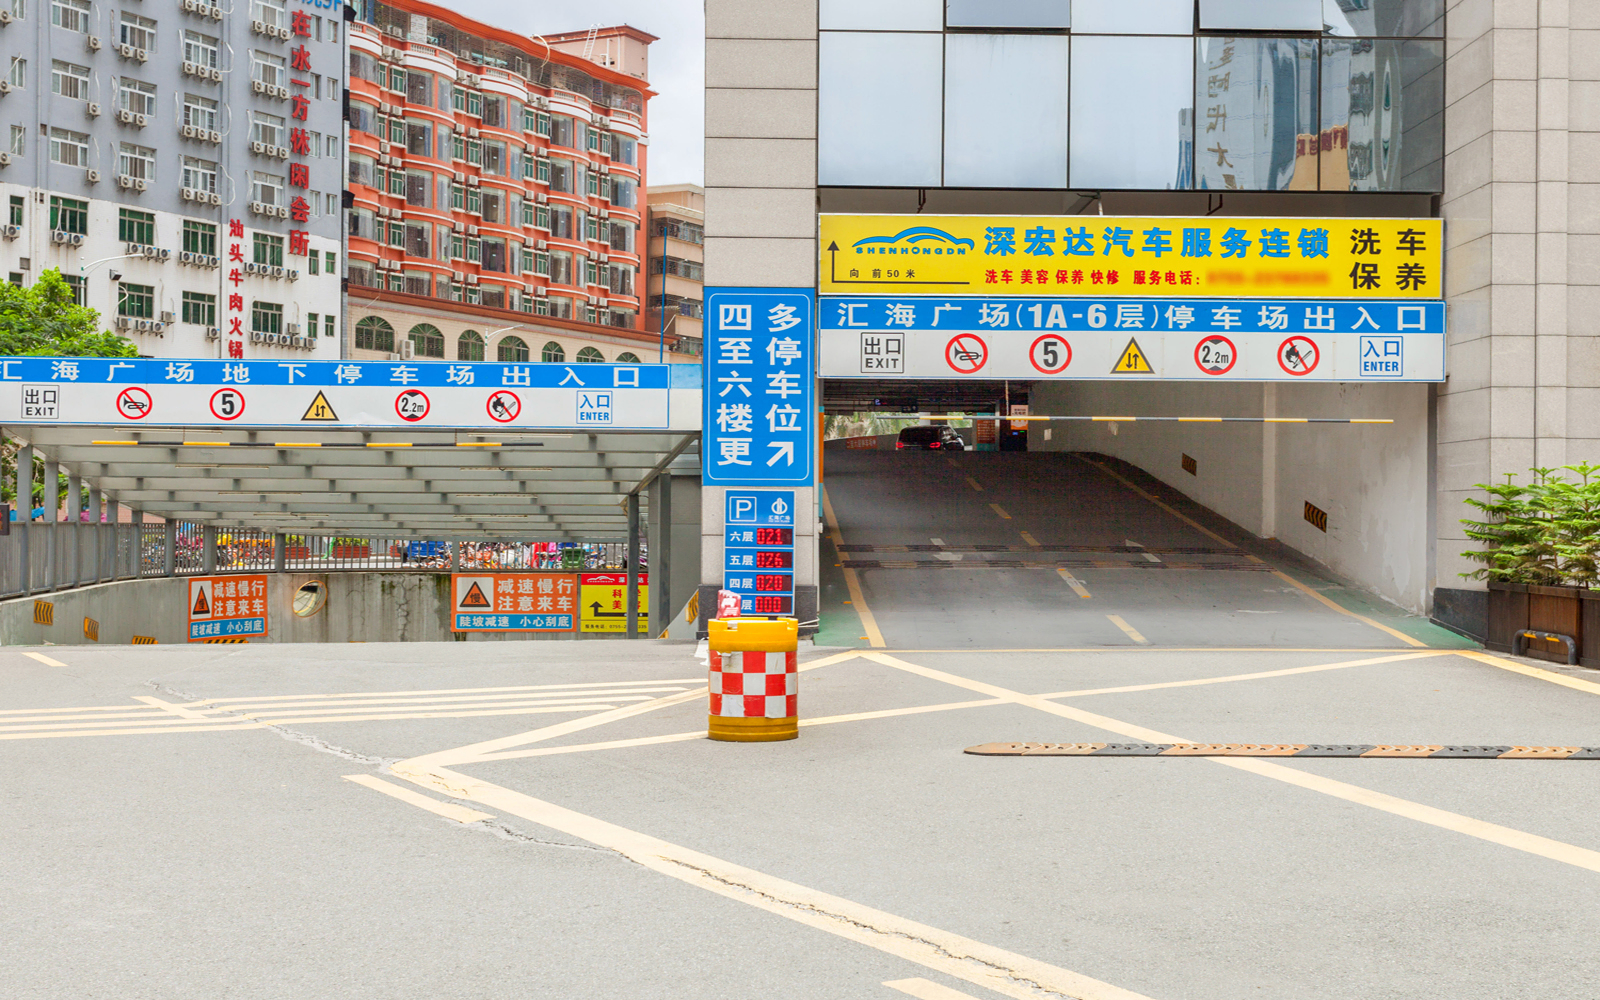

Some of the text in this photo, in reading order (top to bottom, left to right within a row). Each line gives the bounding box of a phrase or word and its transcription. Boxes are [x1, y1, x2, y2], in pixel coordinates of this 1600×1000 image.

[291, 9, 312, 257] 在水一方休闲会所
[984, 226, 1330, 259] 深宏达汽车服务连锁
[1349, 228, 1427, 256] 洗车
[985, 269, 1014, 285] 洗车
[1020, 269, 1049, 285] 美容
[1055, 269, 1084, 285] 保养
[1091, 270, 1120, 285] 快修
[1349, 262, 1427, 291] 保养
[228, 218, 244, 360] 汕头牛肉火锅
[864, 336, 901, 356] 出口
[1043, 341, 1058, 368] 5
[1363, 340, 1400, 358] 入口
[865, 358, 899, 369] EXIT
[1202, 345, 1229, 365] 2.2m
[0, 360, 640, 388] 汇海广场地下停车场出入口
[765, 303, 802, 433] 多停车位
[1363, 361, 1399, 372] ENTER
[716, 304, 753, 467] 四至六楼更
[25, 389, 57, 405] 出口
[221, 393, 235, 416] 5
[401, 397, 424, 413] 2.2m
[579, 394, 610, 409] 入口
[26, 407, 55, 416] EXIT
[580, 411, 610, 422] ENTER
[736, 499, 752, 519] P
[730, 531, 754, 542] 六层
[756, 528, 783, 545] 021
[729, 555, 754, 566] 五层
[756, 552, 783, 568] 026
[214, 580, 265, 598] 减速慢行
[497, 578, 574, 594] 减速慢行
[729, 578, 754, 589] 四层
[756, 574, 783, 591] 020
[469, 592, 481, 603] 慢
[497, 595, 573, 612] 注意来车
[741, 599, 753, 611] 层
[755, 596, 782, 613] 000
[214, 598, 265, 617] 注意来车
[226, 619, 263, 633] 小心刮底
[459, 616, 570, 627] 陡坡减速 小心刮底
